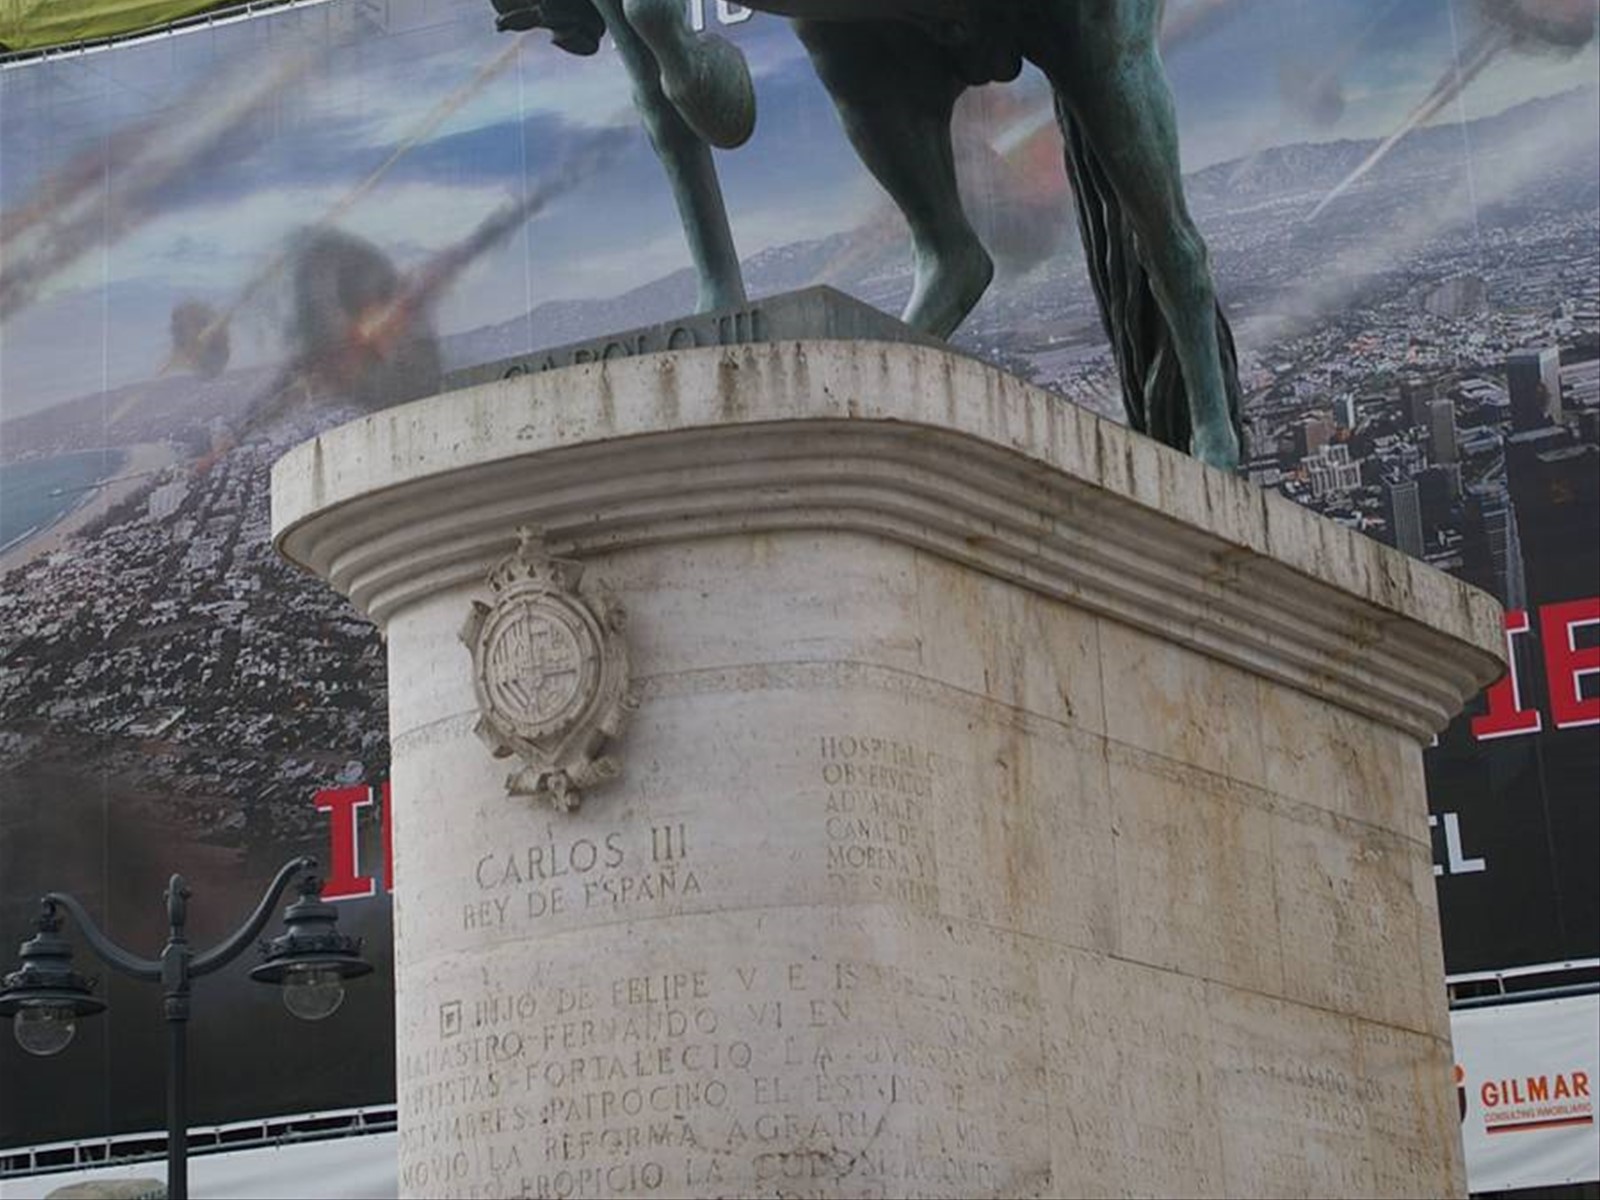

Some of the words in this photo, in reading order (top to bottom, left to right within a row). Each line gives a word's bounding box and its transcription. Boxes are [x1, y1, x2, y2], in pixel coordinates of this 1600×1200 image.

[475, 831, 624, 891] CARLOS
[651, 823, 688, 862] III
[463, 895, 510, 931] REY
[528, 887, 565, 920] DE
[556, 986, 595, 1016] DE
[612, 971, 710, 1008] FELIPE
[736, 967, 758, 991] V
[1481, 1071, 1590, 1107] GILMAR
